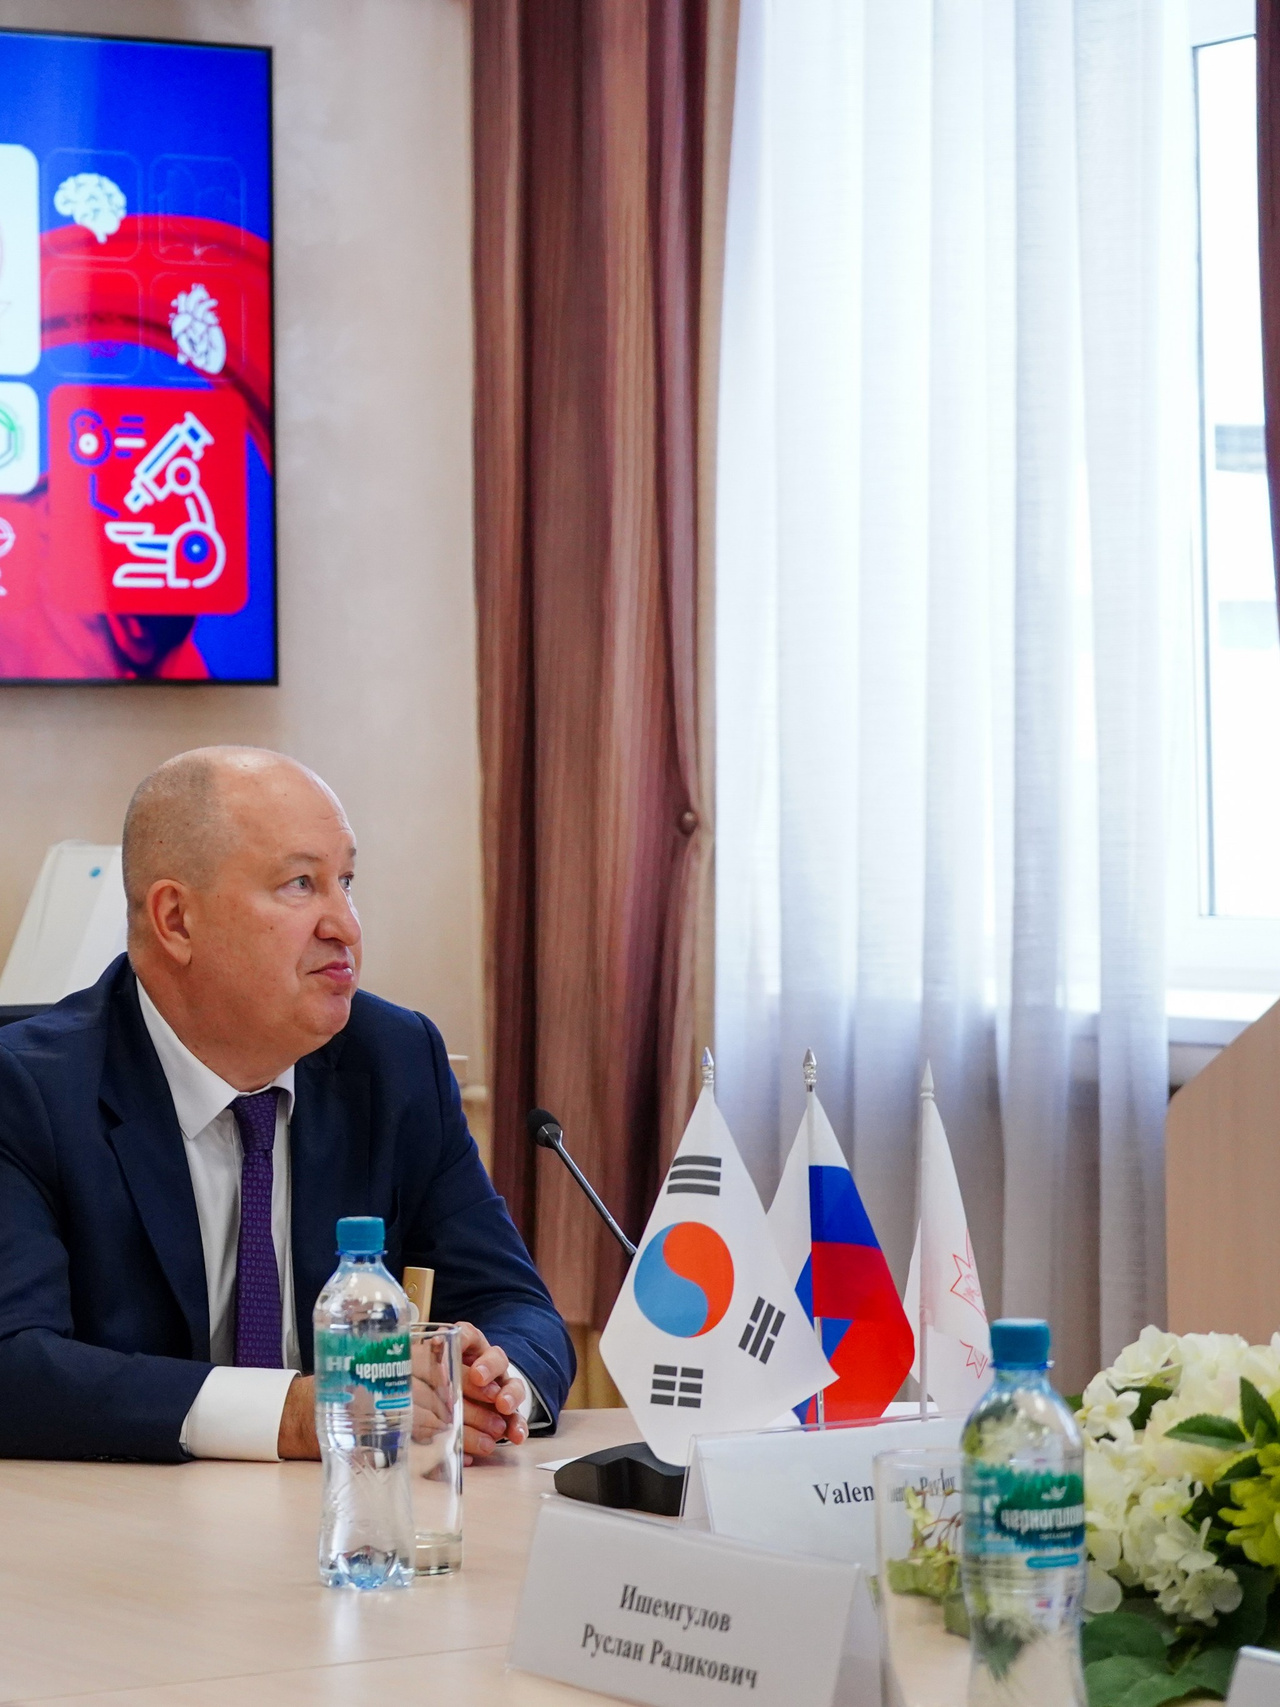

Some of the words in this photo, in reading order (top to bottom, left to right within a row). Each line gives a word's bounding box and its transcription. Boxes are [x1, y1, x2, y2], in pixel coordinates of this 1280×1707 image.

[620, 1584, 732, 1632] Ишемгулов
[581, 1623, 645, 1658] Руслан
[649, 1639, 760, 1689] Радикович
